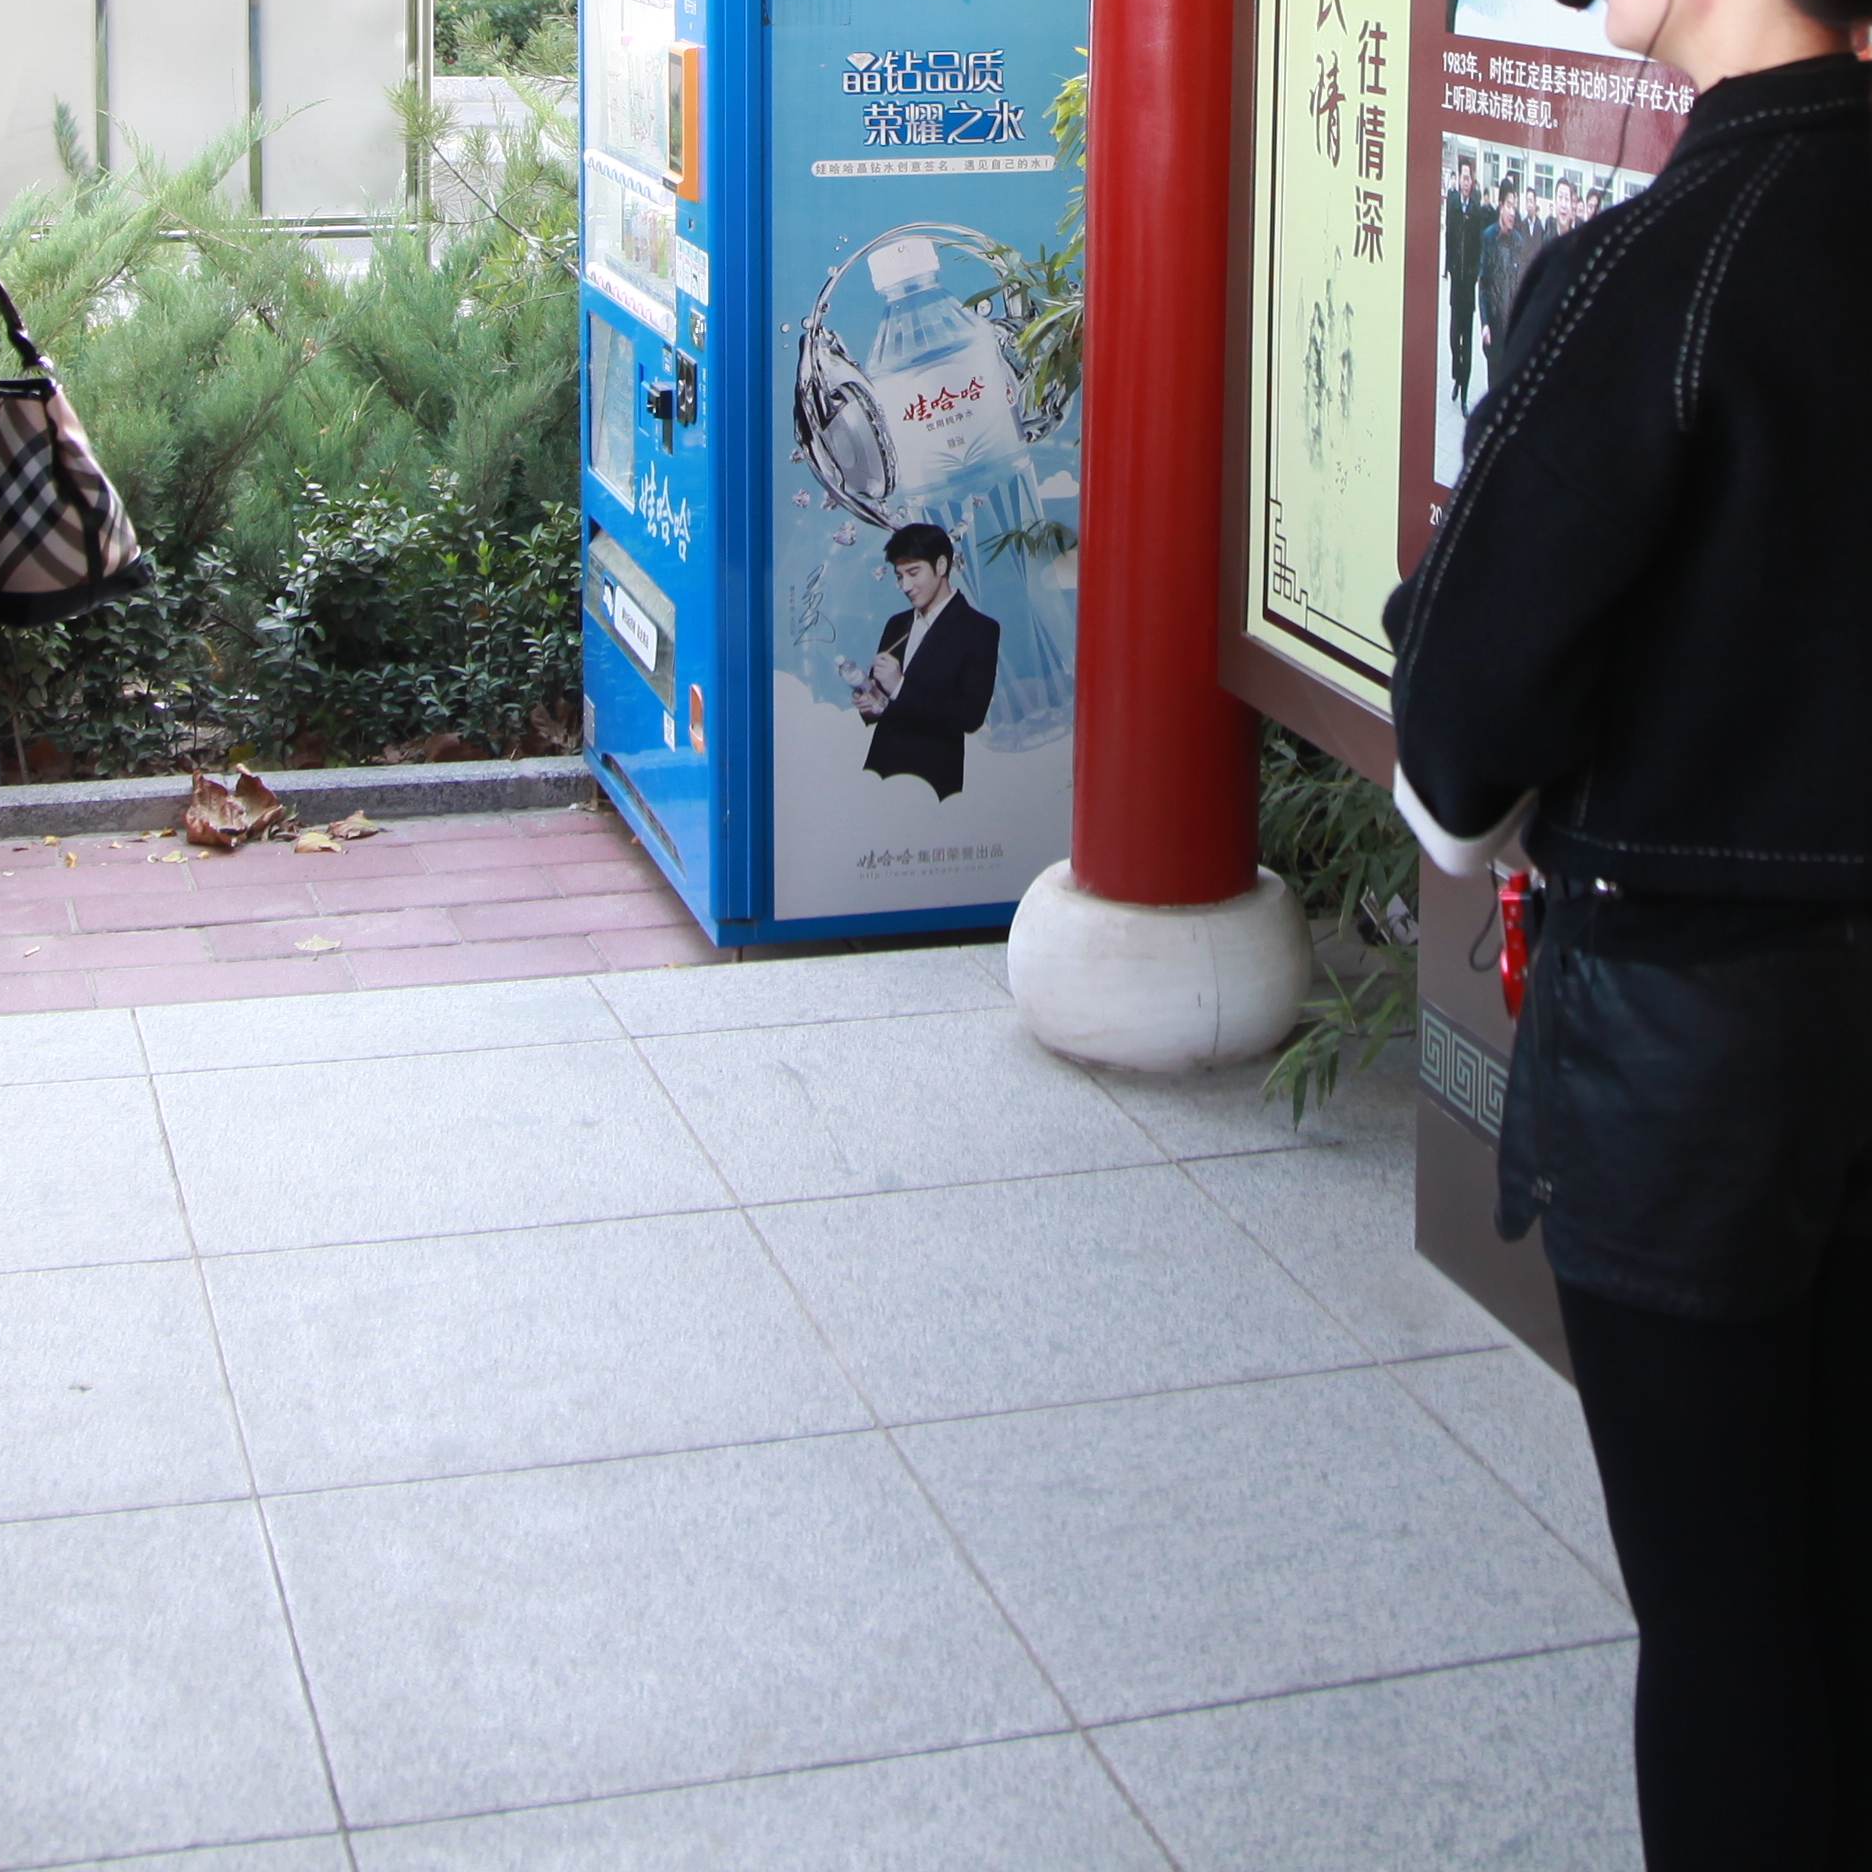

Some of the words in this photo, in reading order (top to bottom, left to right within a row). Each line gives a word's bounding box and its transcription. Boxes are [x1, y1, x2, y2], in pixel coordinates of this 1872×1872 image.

[842, 49, 1005, 95] 晶钻品质
[863, 99, 1026, 146] 荣耀之水
[1441, 82, 1559, 130] 上听取来访群众意见。
[902, 376, 986, 422] 娃哈哈
